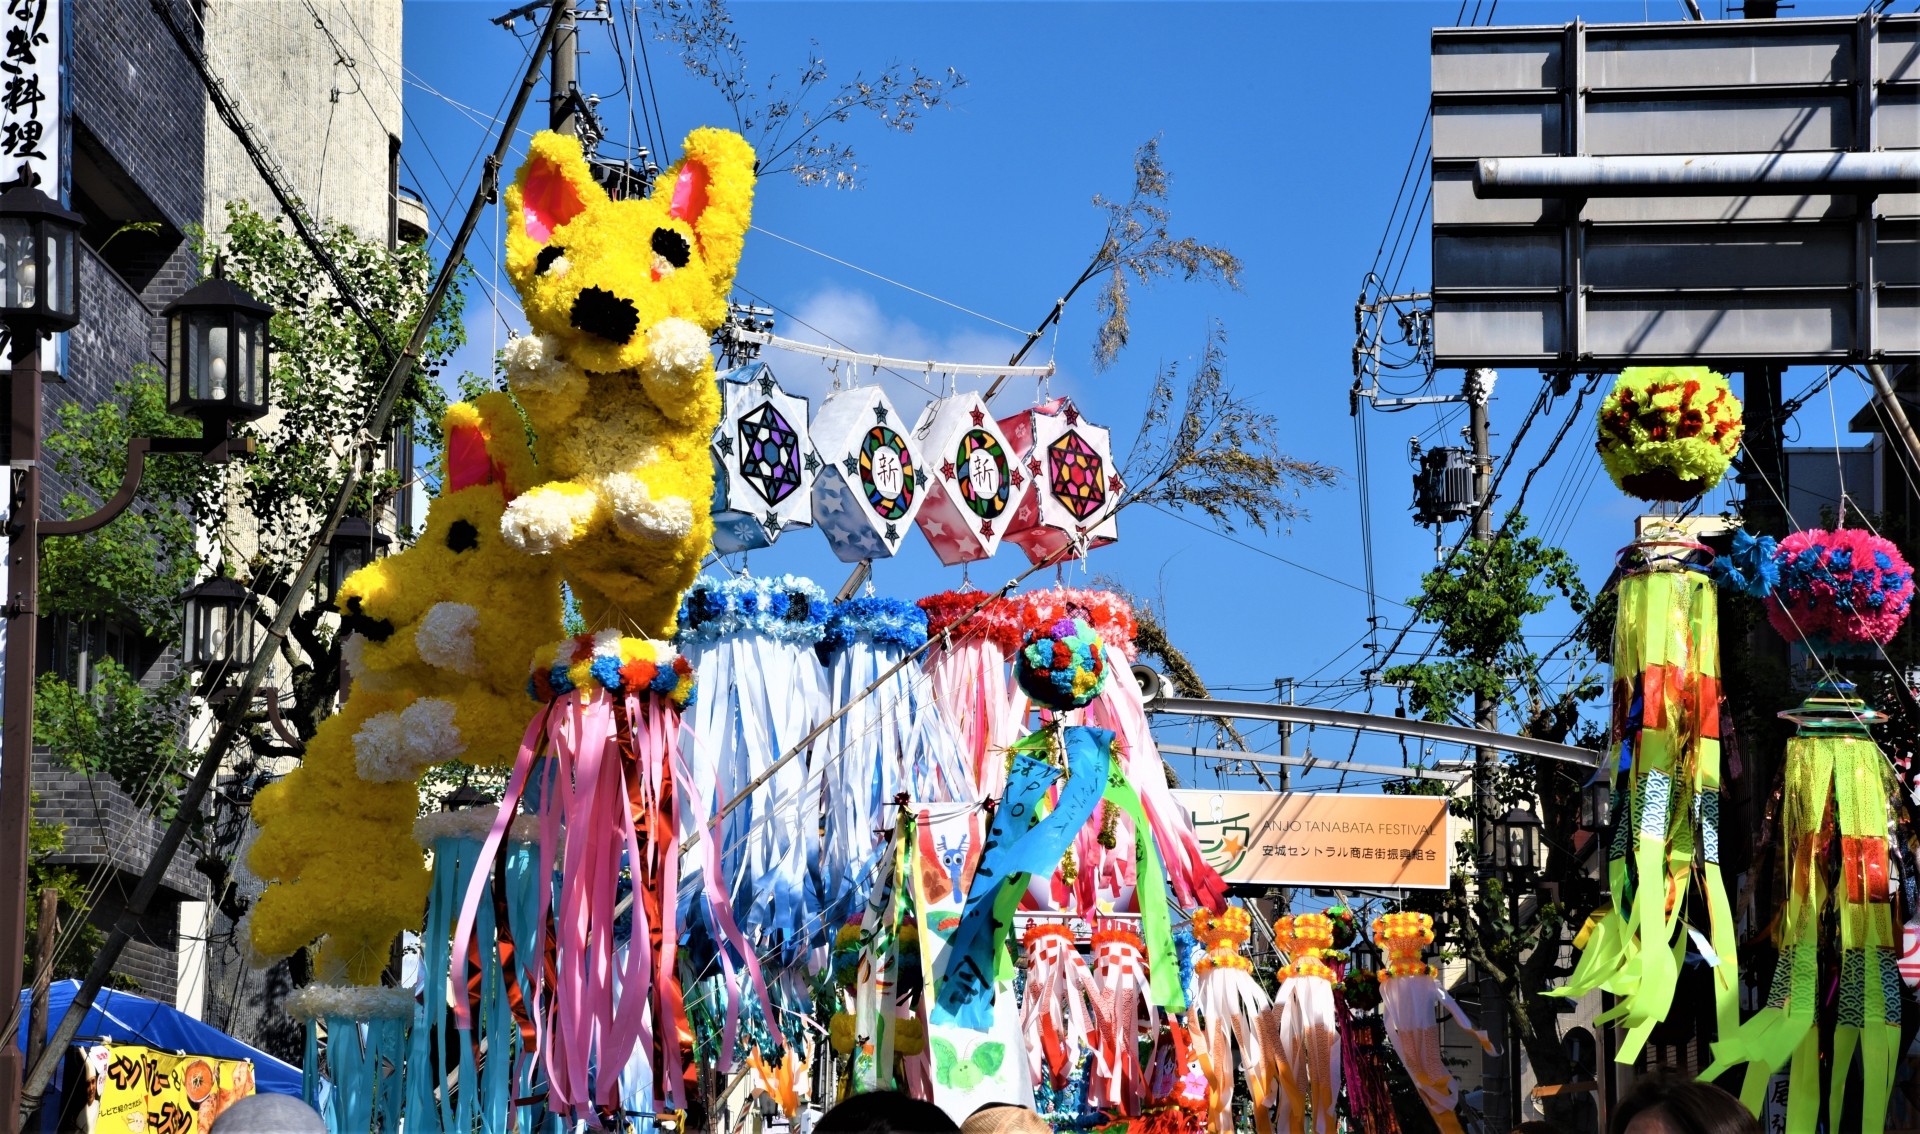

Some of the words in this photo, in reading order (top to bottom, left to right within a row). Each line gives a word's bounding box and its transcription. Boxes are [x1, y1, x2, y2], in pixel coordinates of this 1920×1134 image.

[877, 453, 899, 492] 新
[972, 455, 995, 492] 新
[1261, 820, 1302, 833] ANJO
[1305, 821, 1375, 834] TANABATA
[1378, 823, 1437, 836] FESTIVAL
[1262, 845, 1437, 861] 安城セントラル商店街振興組合
